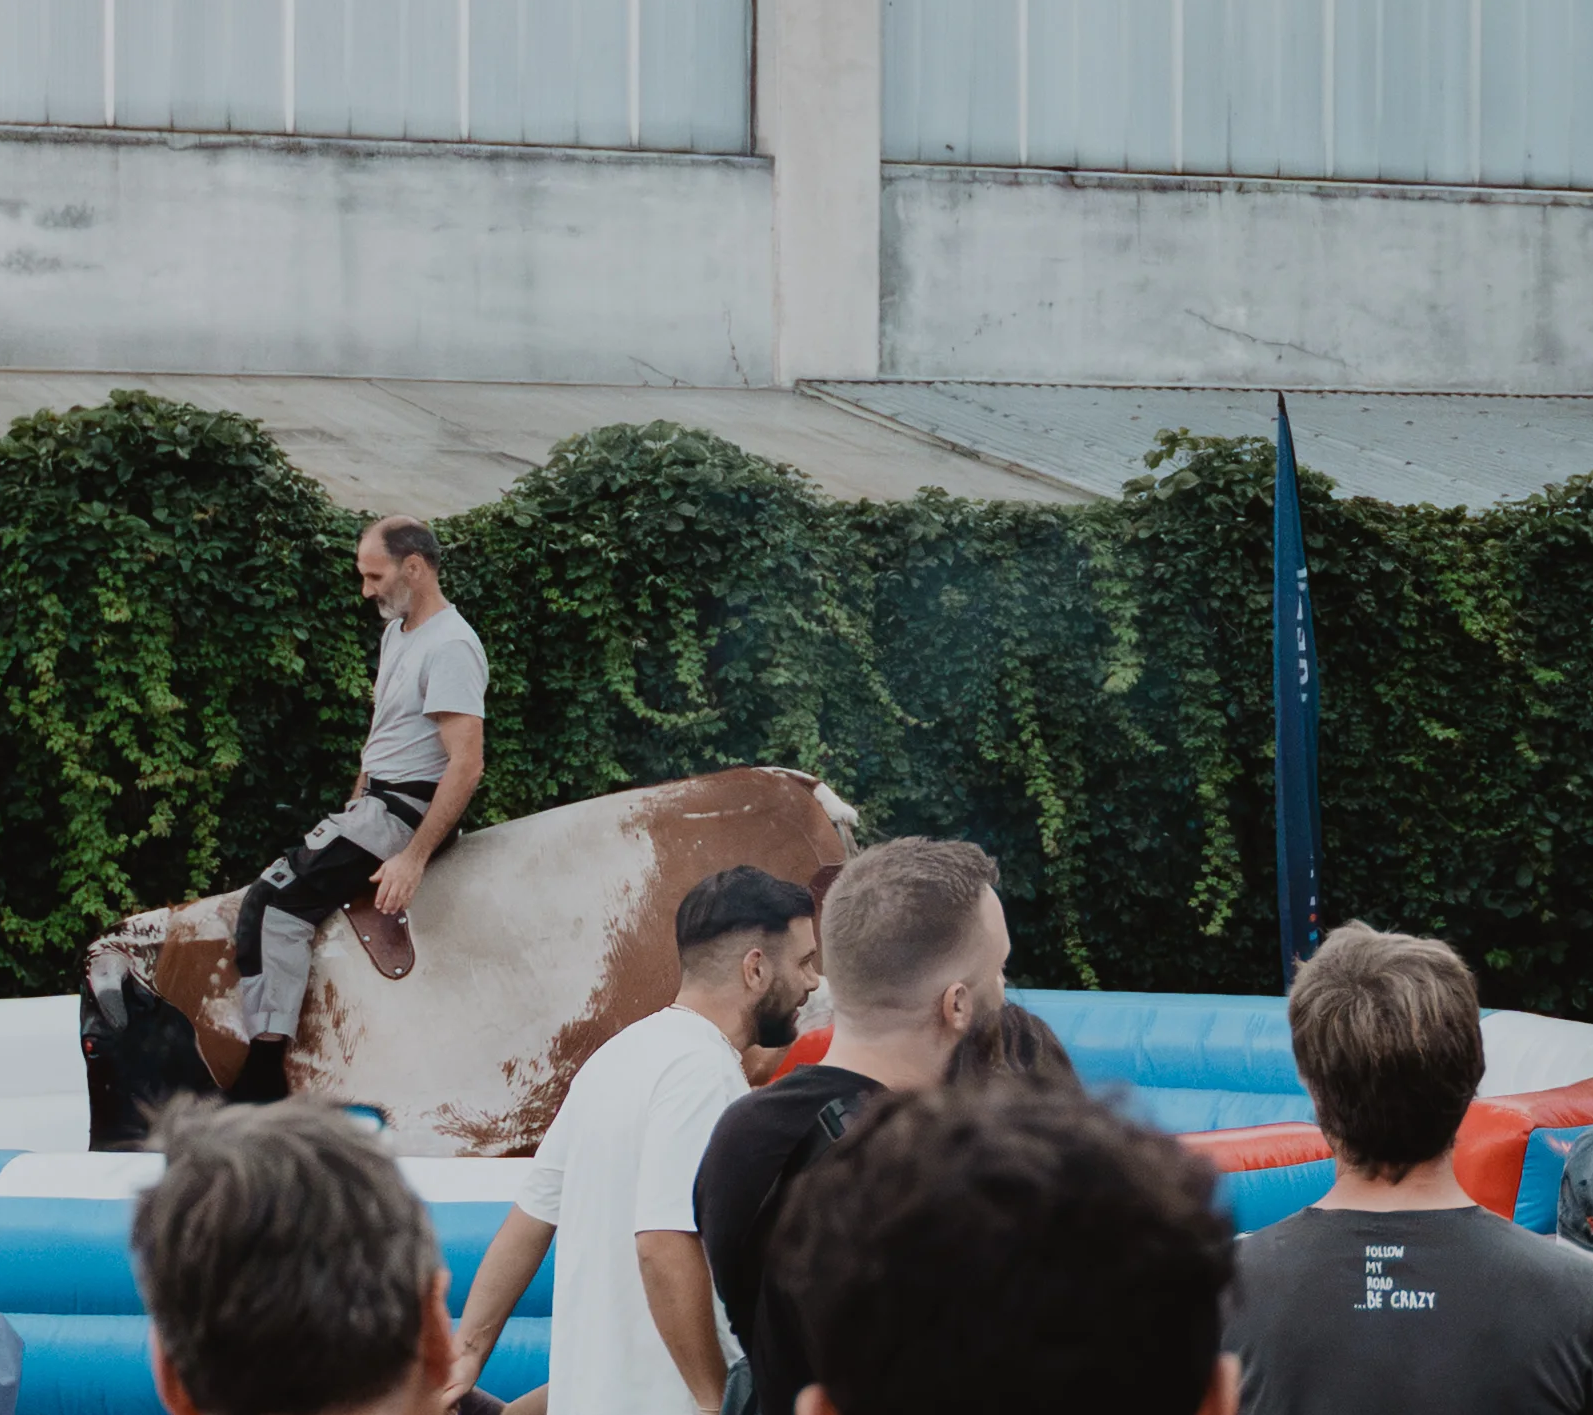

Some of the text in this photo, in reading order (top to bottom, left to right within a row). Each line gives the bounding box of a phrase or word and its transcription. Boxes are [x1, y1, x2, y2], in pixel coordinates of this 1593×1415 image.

[1365, 1245, 1405, 1258] FOLLOW
[1365, 1261, 1383, 1274] MY
[1366, 1276, 1394, 1290] ROAD
[1390, 1290, 1436, 1309] CRAZY
